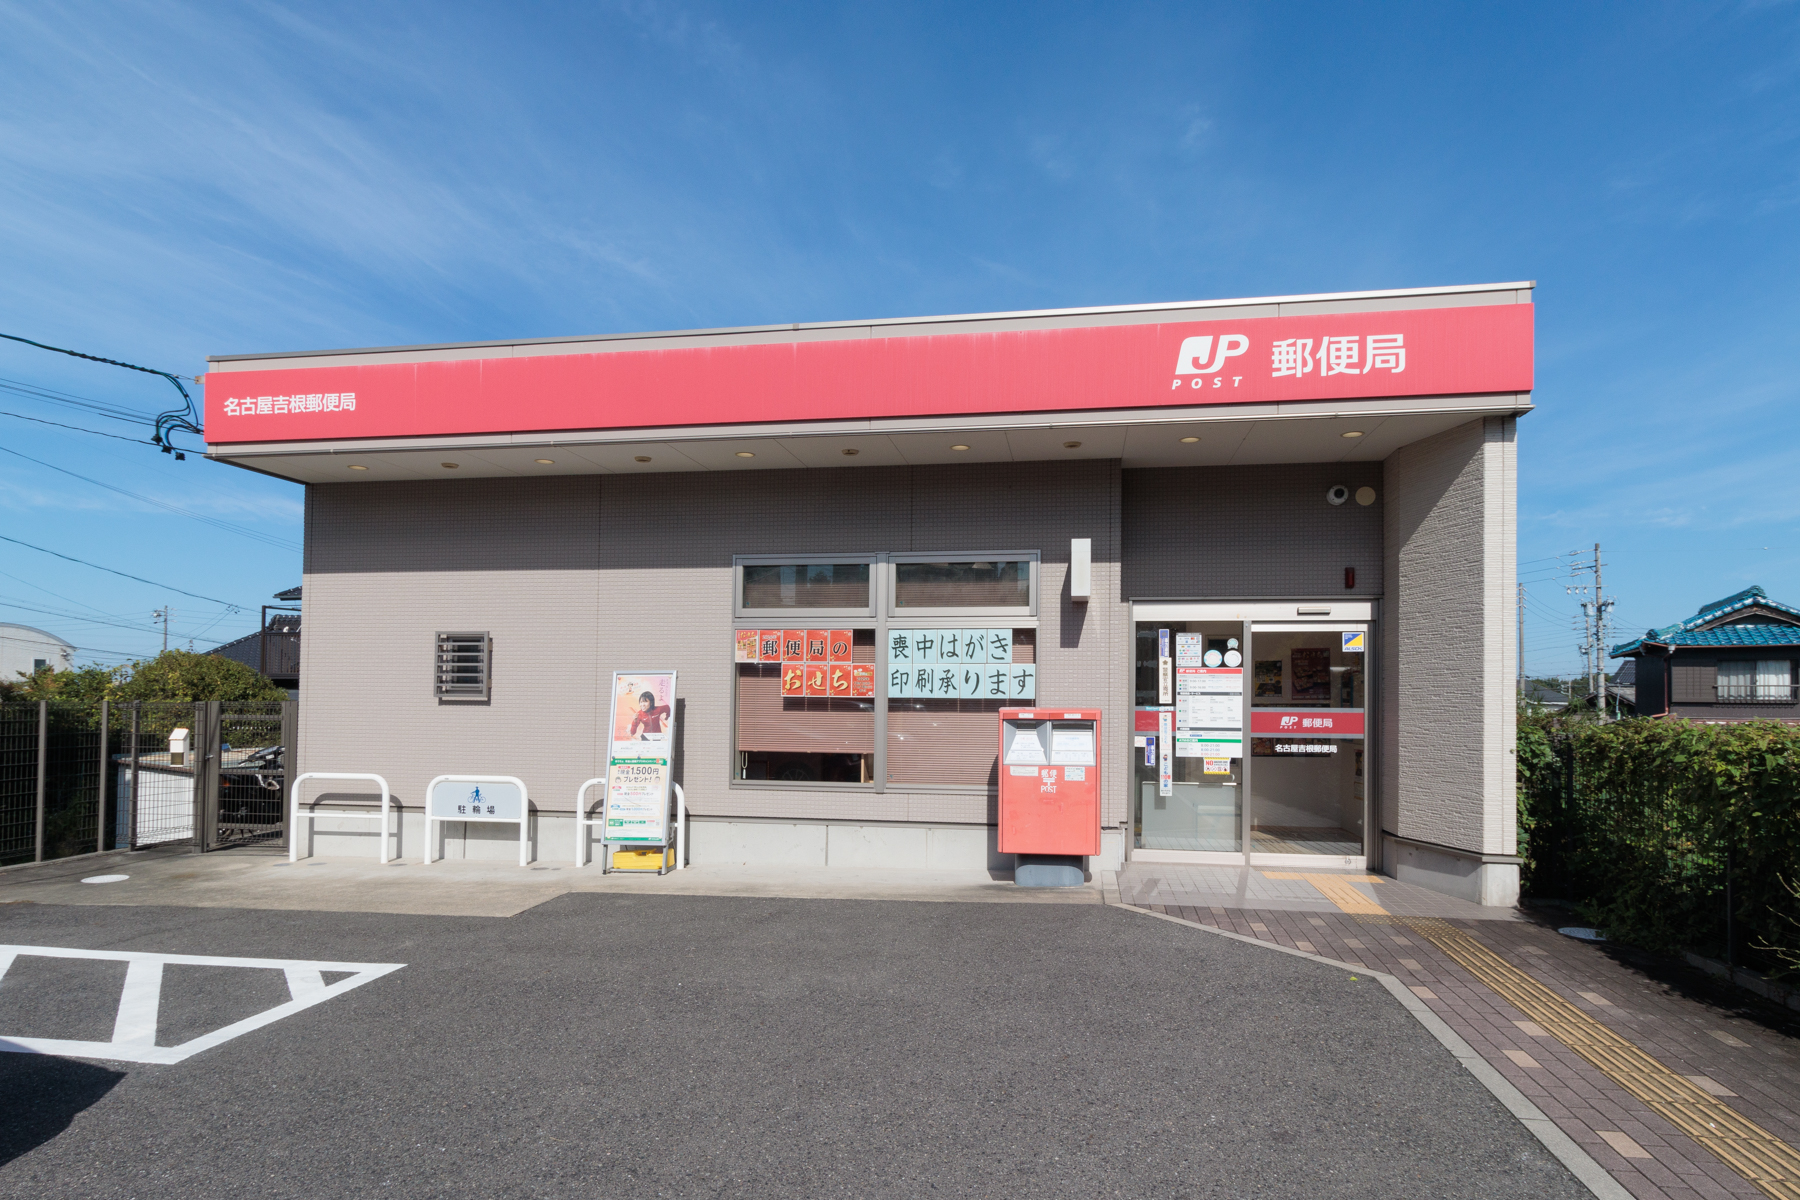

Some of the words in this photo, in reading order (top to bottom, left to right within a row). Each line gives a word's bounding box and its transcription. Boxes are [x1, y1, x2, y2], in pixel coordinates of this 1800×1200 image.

[1271, 333, 1405, 378] 郵便局
[1171, 376, 1243, 390] POST
[223, 392, 356, 416] 名古屋吉根郵便局
[761, 639, 848, 657] 郵便局の
[891, 633, 1009, 660] 喪中はがき
[783, 668, 850, 691] おせち
[891, 668, 1034, 695] 印刷承ります
[1302, 718, 1333, 728] 郵便局
[1275, 744, 1338, 753] 名古屋吉根郵便局
[1041, 769, 1057, 779] 郵便
[1041, 785, 1057, 793] POST
[457, 805, 496, 815] 駐輪場
